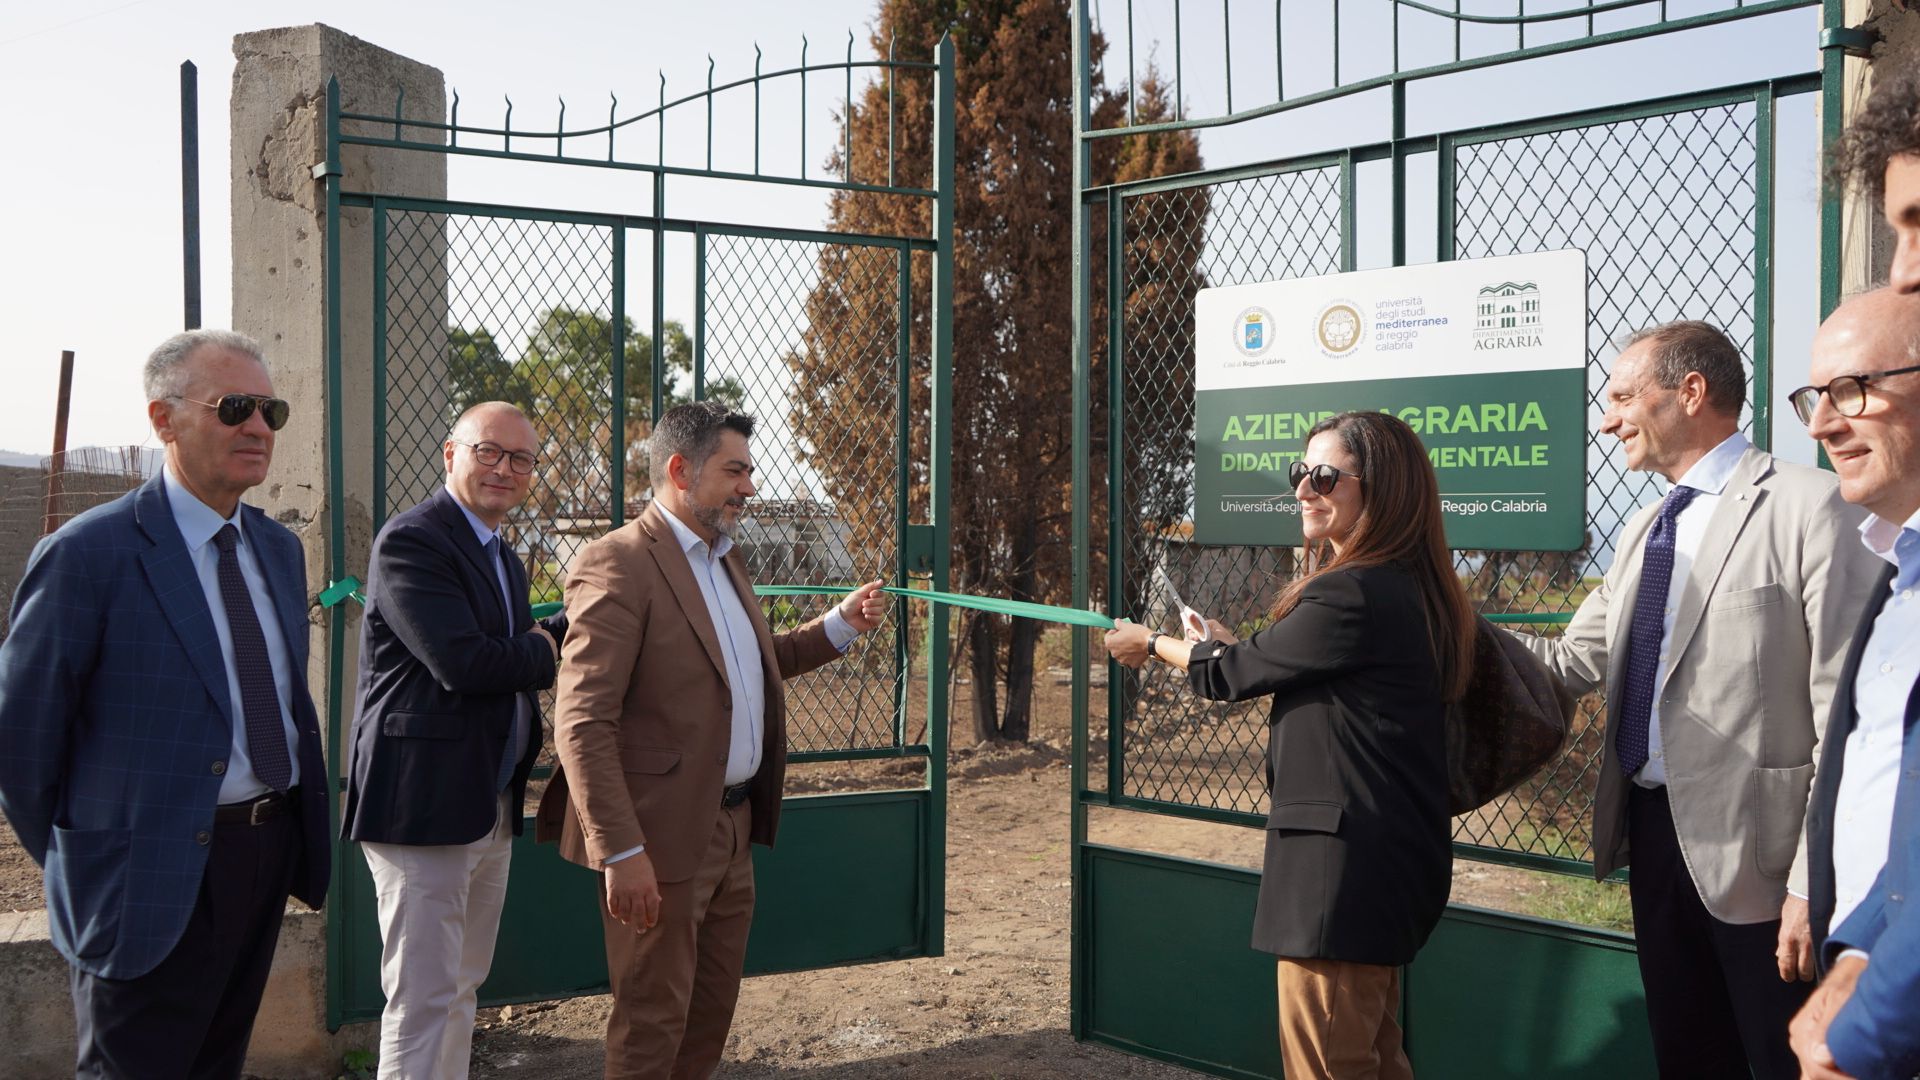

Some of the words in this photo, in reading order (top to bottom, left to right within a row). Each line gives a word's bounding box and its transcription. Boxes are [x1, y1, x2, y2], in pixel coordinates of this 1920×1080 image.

[1376, 296, 1423, 309] università
[1376, 309, 1399, 320] degli
[1401, 306, 1426, 317] studi
[1376, 317, 1448, 330] mediterranea
[1376, 331, 1385, 340] di
[1386, 330, 1418, 342] reggio
[1472, 328, 1532, 339] DIPARTIMENTO
[1376, 341, 1413, 351] calabria
[1474, 336, 1543, 351] AGRARIA
[1222, 410, 1357, 441] AZIEN
[1380, 401, 1549, 434] GRARIA
[1221, 500, 1273, 512] Università
[1275, 501, 1303, 515] degli
[1441, 500, 1488, 515] Reggio
[1491, 500, 1547, 513] Calabria
